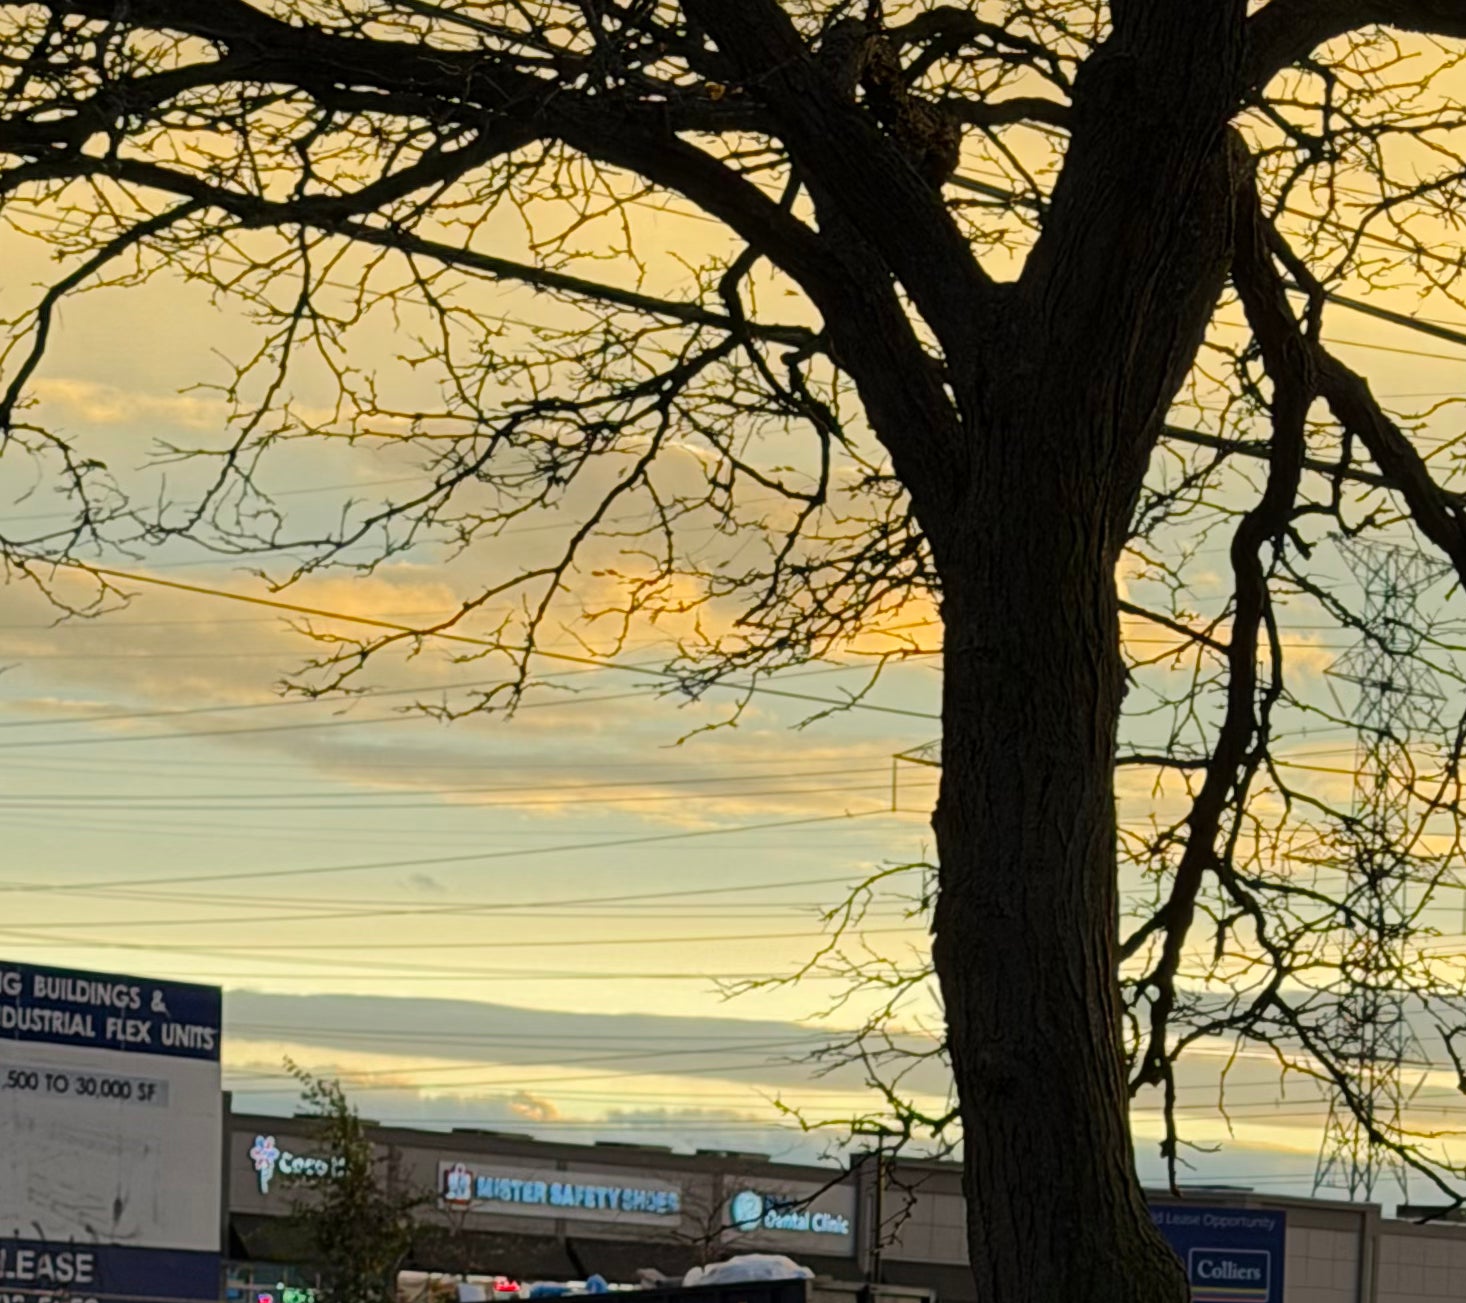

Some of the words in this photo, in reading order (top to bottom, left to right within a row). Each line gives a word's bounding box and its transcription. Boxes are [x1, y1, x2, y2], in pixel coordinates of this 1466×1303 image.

[0, 971, 22, 996] G
[34, 974, 141, 1010] BUILDINGS
[150, 989, 169, 1013] &
[0, 1005, 96, 1038] DUSTRIAL
[106, 1016, 151, 1043] FLEX
[161, 1022, 215, 1050] UNITS
[46, 1074, 69, 1094] TO
[75, 1077, 132, 1101] 30,000
[137, 1082, 157, 1102] SF
[475, 1176, 547, 1204] MISTER
[550, 1183, 620, 1210] SAFETY
[621, 1188, 681, 1214] SHOES
[764, 1208, 810, 1231] Dental
[811, 1212, 849, 1235] Clinic
[1166, 1212, 1200, 1225] Lease
[1203, 1214, 1276, 1232] Opportunity
[1197, 1260, 1262, 1281] Colliers
